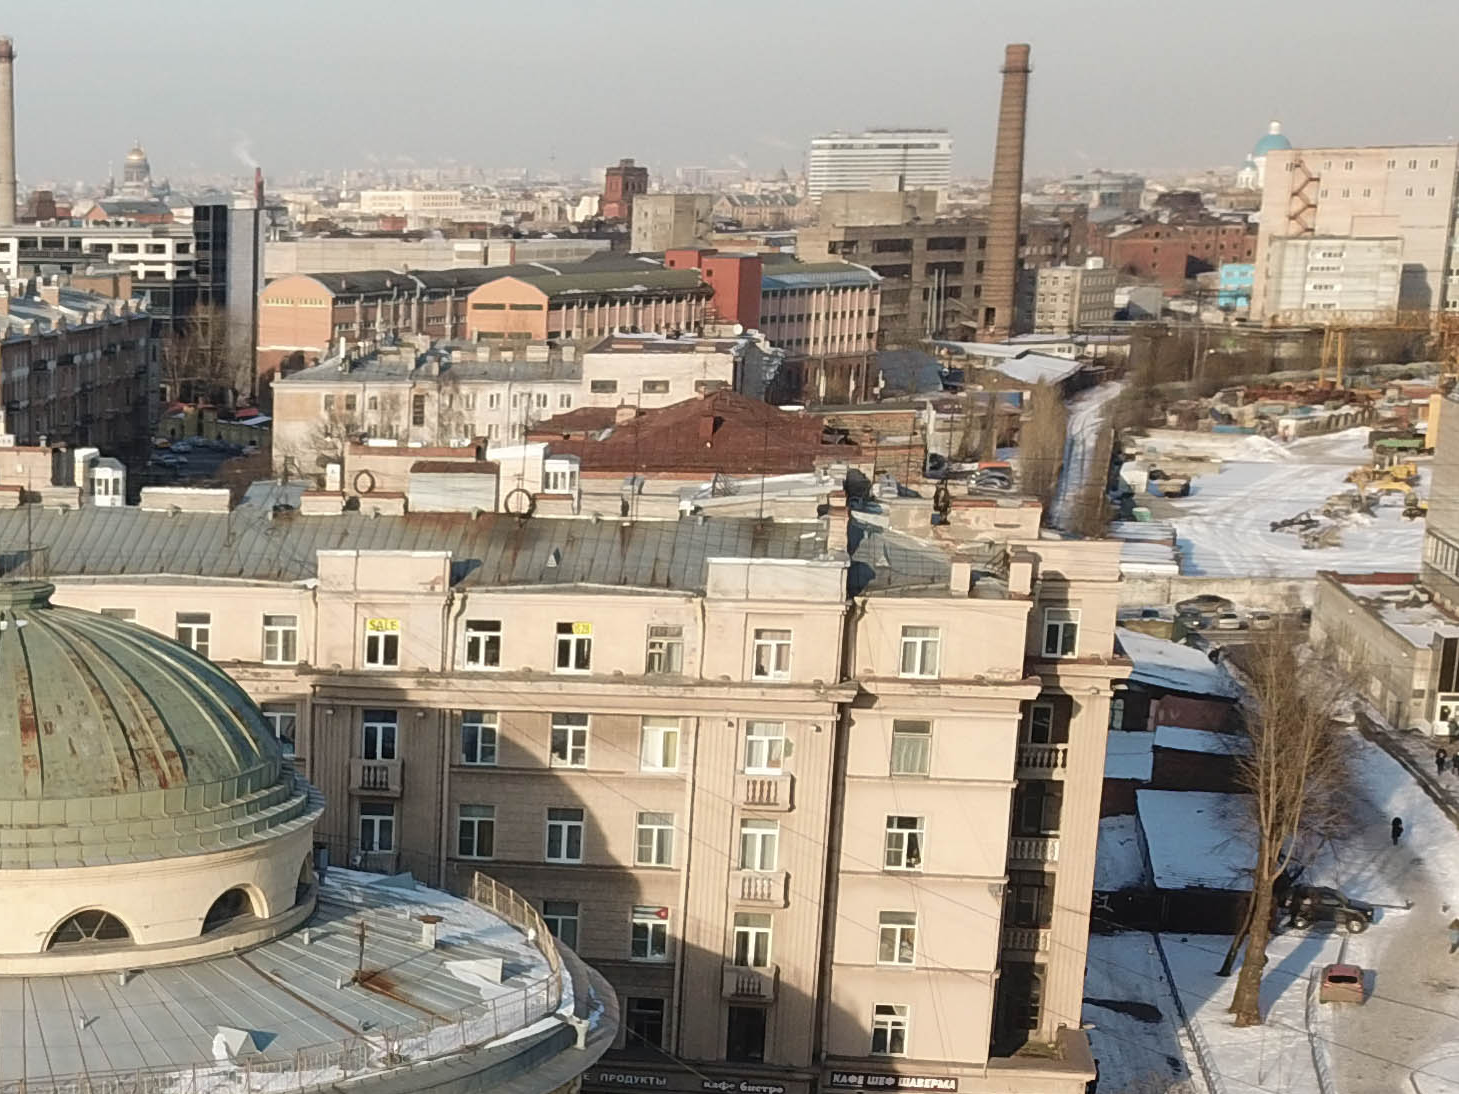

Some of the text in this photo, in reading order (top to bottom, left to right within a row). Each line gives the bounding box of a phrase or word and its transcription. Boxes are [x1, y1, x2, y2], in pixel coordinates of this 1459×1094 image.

[368, 618, 398, 631] SALE
[600, 1073, 667, 1086] ПРОДУКТЫ
[833, 1073, 957, 1090] КАФЕ ШЕФ ШАВЕРМА
